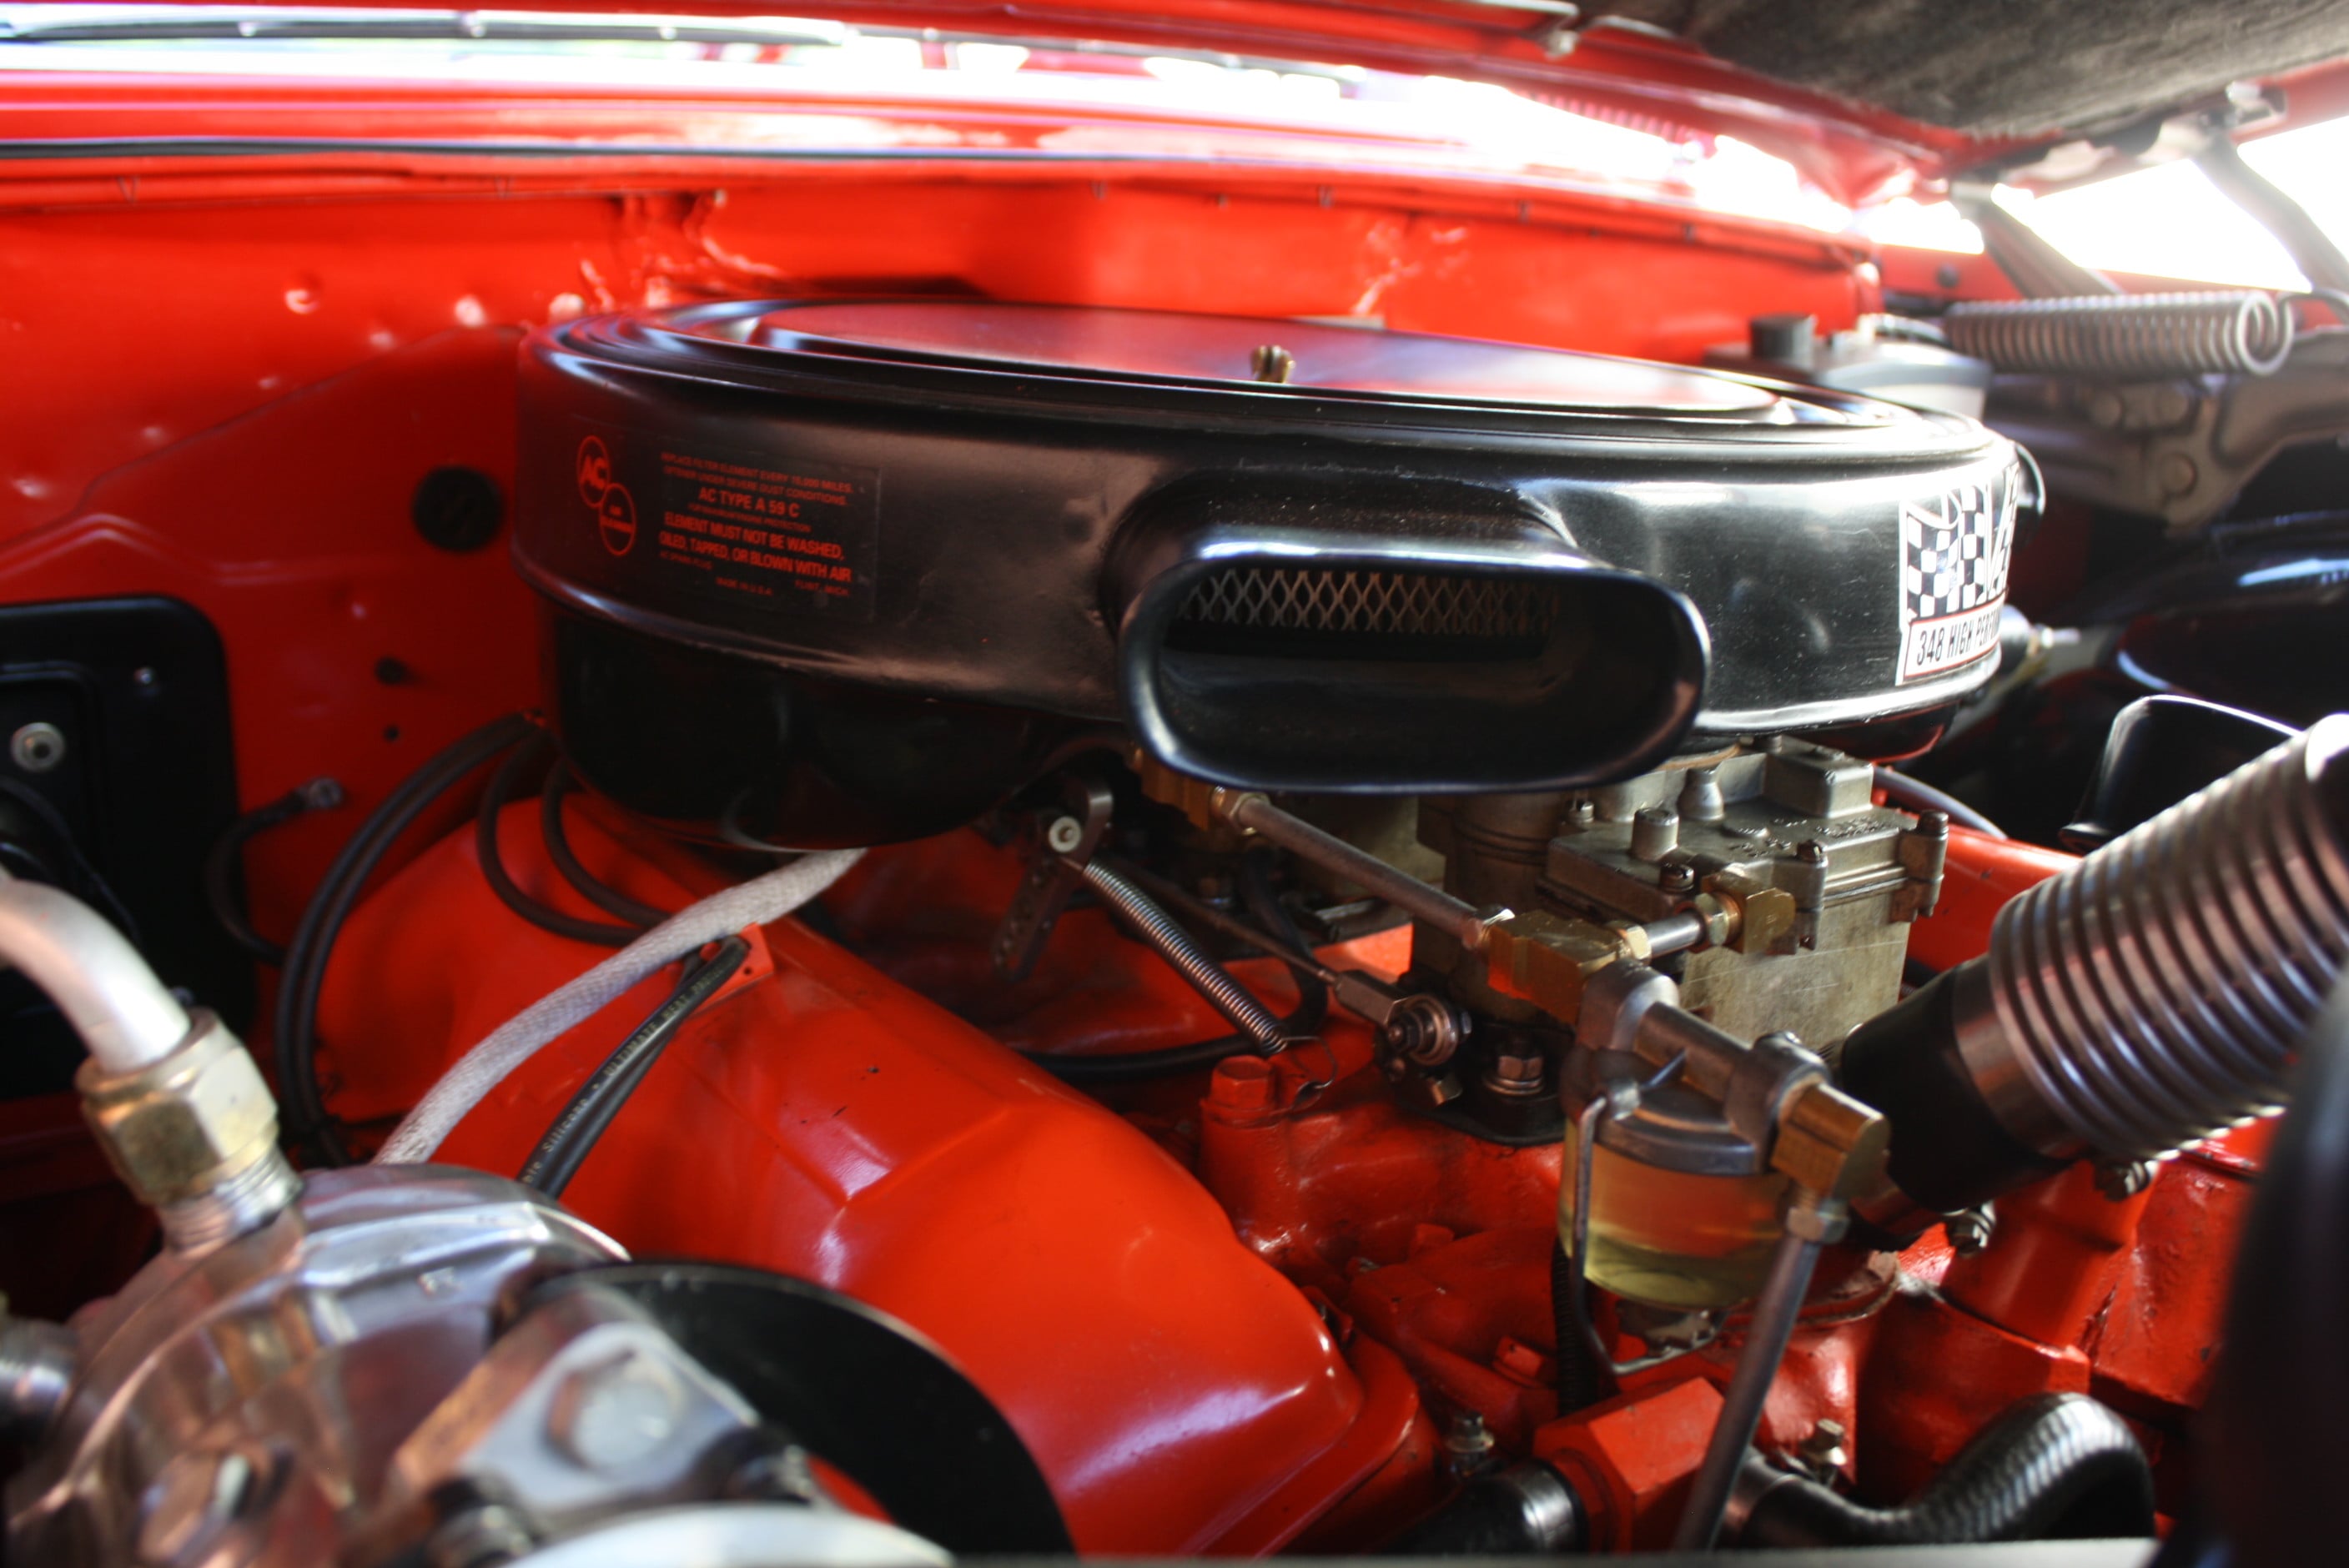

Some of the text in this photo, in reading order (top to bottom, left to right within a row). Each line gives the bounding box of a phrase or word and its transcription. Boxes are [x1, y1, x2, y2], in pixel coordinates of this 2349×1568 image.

[581, 455, 609, 490] AC
[721, 464, 757, 477] ELEMENT
[761, 470, 787, 482] EVERY
[760, 483, 784, 495] DUST
[699, 486, 801, 518] AC TYPE A 59 C
[664, 511, 844, 560] ELEMENT MUST NOT BE WASHED,
[691, 538, 729, 560] TAPPED,
[732, 547, 747, 563] OR
[750, 550, 792, 571] BLOWN
[796, 560, 827, 578] WITH
[830, 565, 852, 582] AIR
[1917, 627, 1945, 666] 348
[1947, 620, 1974, 658] HIGH
[541, 1098, 589, 1153] Silicone
[602, 1021, 657, 1077] ULTIMATE
[660, 994, 691, 1021] HEAT
